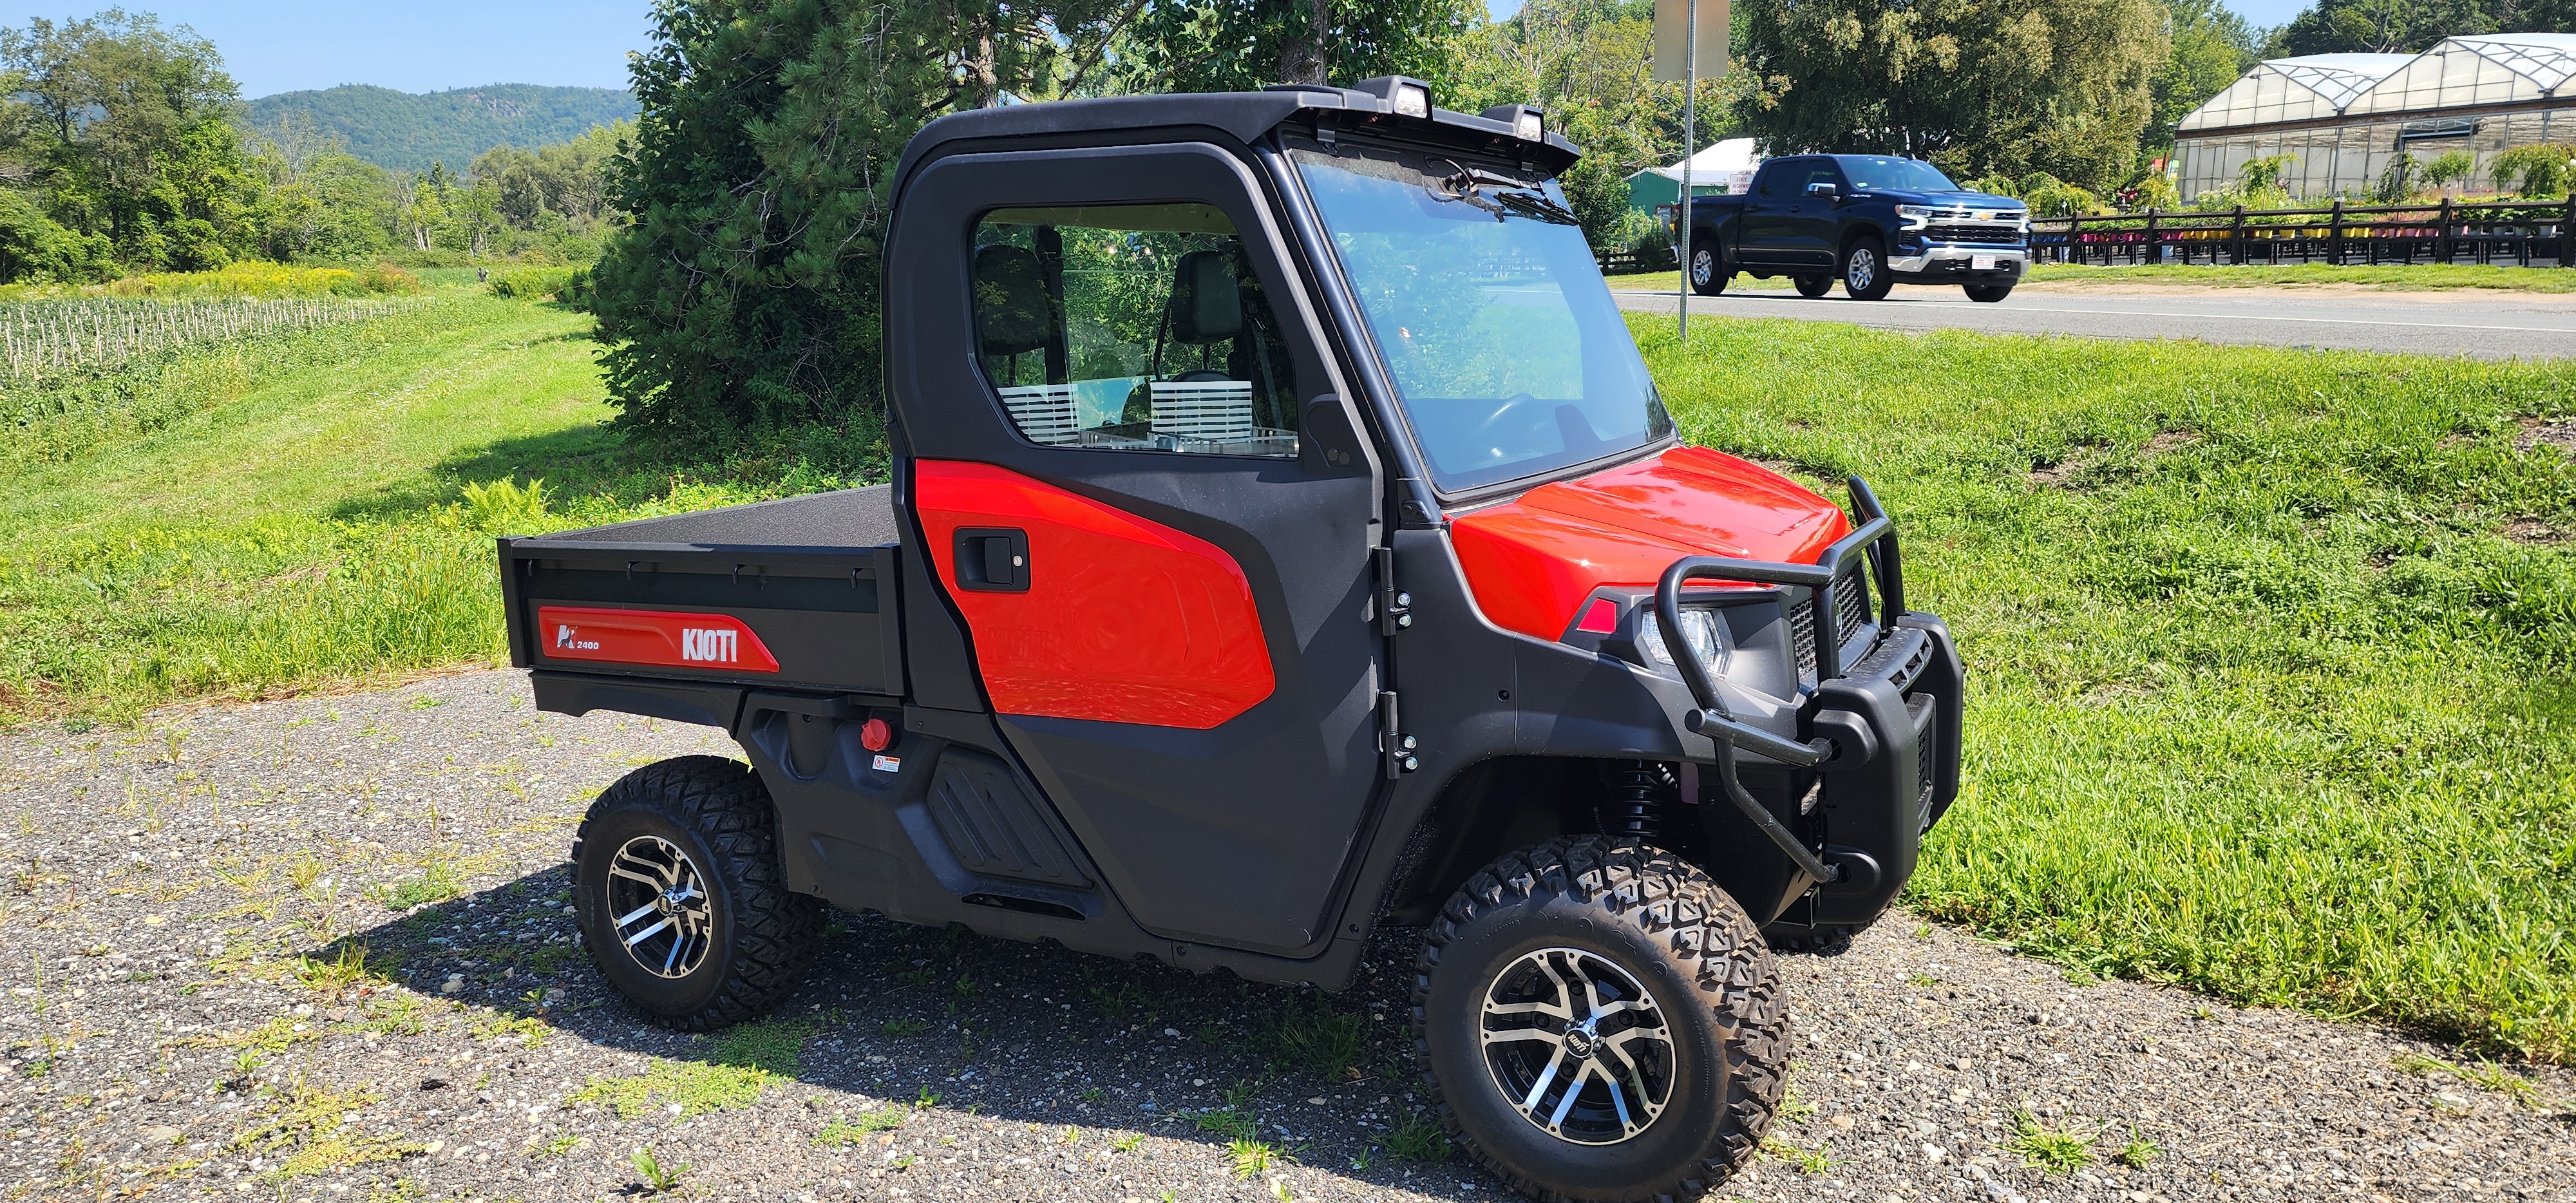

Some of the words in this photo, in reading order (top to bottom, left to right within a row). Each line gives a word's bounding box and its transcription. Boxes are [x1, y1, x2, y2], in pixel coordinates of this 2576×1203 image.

[577, 641, 599, 650] 2400
[683, 629, 737, 662] KIOTI
[1567, 1034, 1590, 1052] KIOTI
